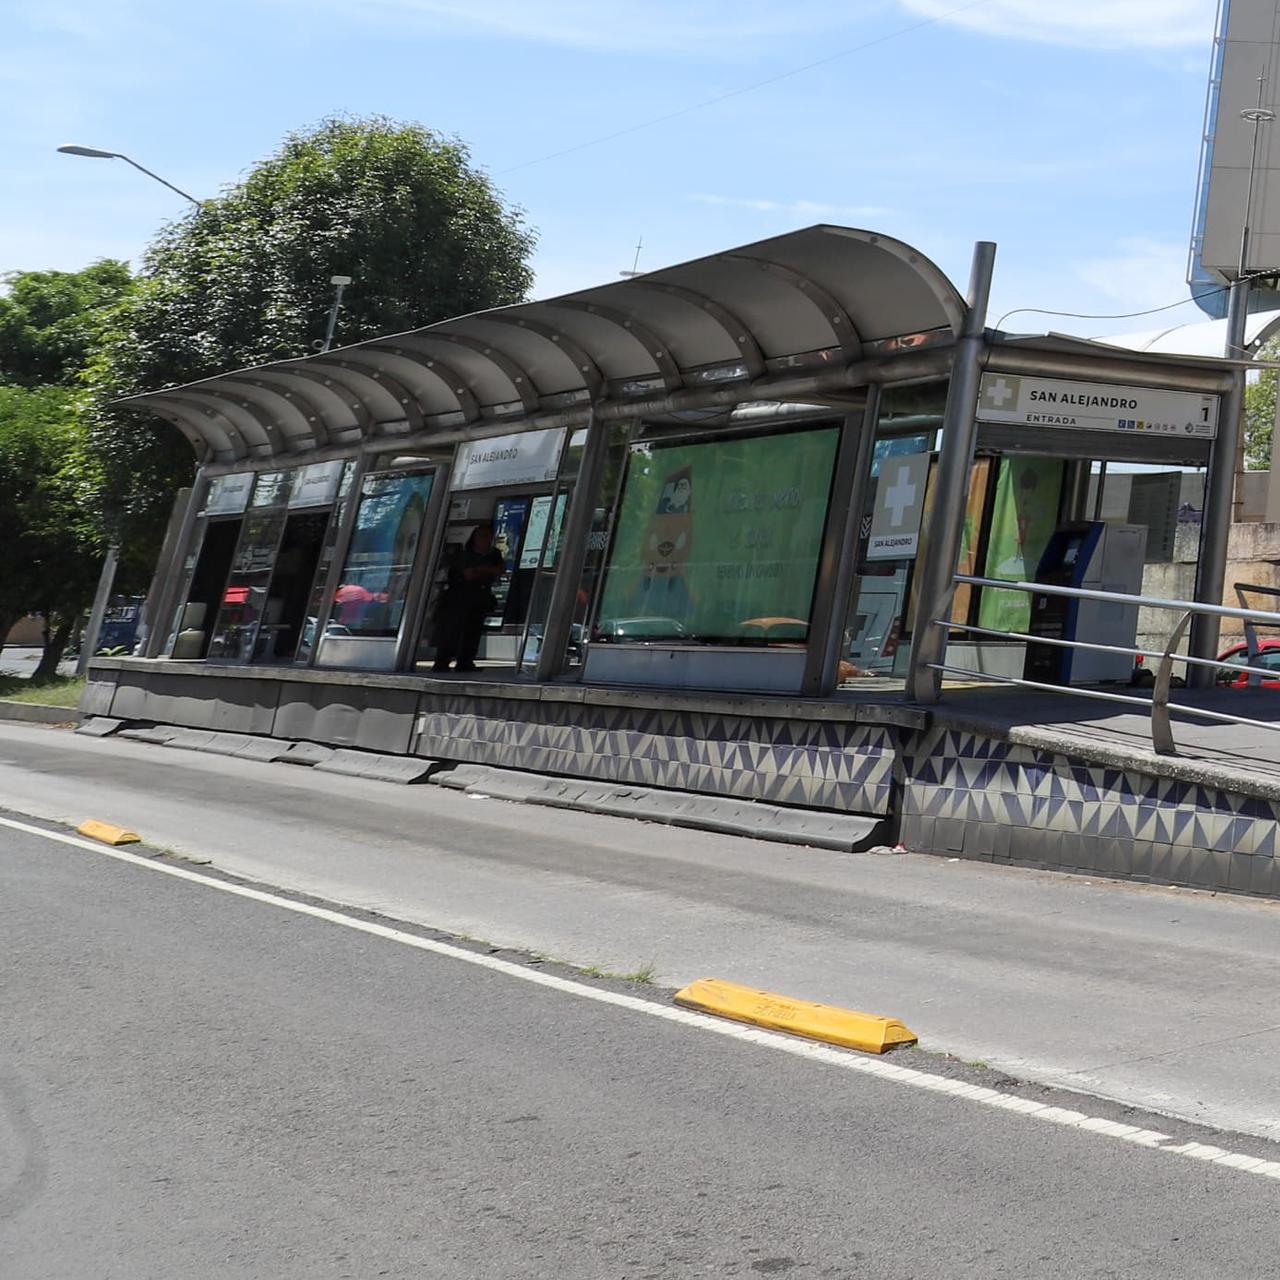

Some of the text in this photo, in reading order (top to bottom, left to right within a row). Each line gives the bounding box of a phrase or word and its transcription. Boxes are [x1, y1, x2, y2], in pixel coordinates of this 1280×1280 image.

[1030, 390, 1137, 410] SAN ALEJANDRO
[1026, 414, 1076, 425] ENTRADA
[1201, 407, 1209, 422] 1
[470, 448, 518, 465] SAN ALEJANDRO
